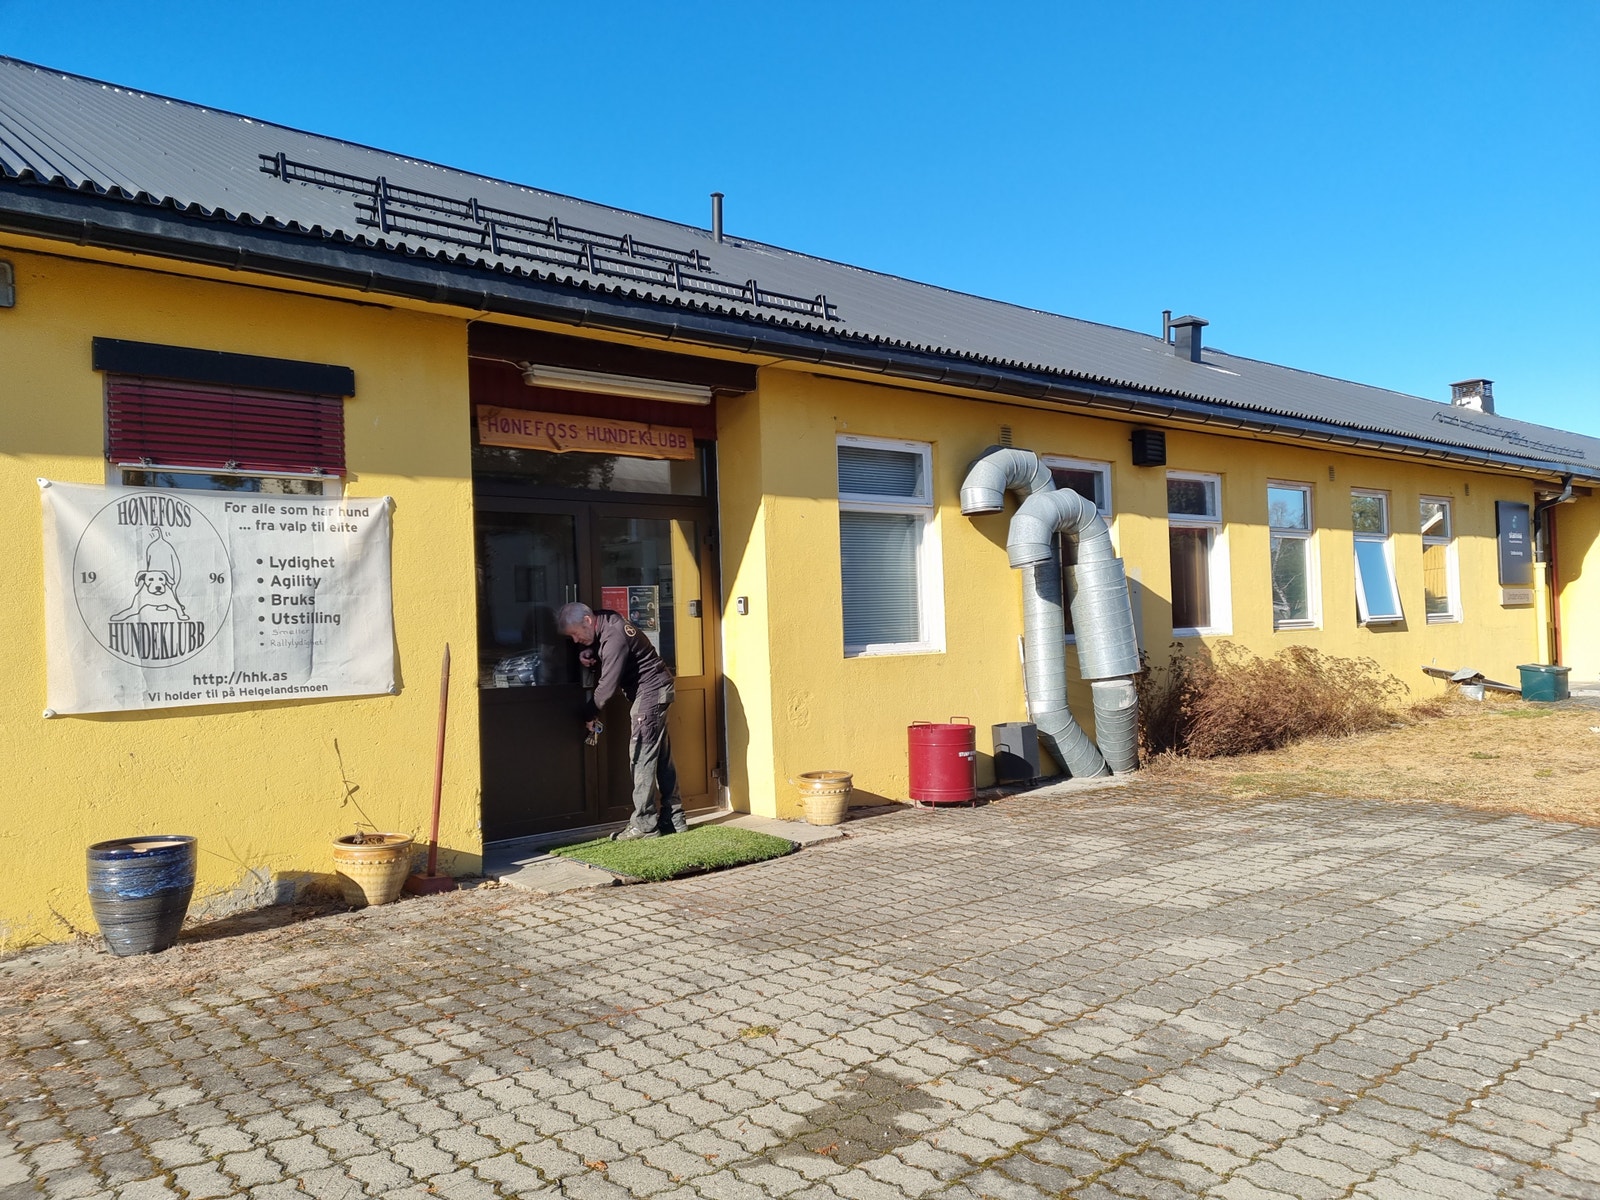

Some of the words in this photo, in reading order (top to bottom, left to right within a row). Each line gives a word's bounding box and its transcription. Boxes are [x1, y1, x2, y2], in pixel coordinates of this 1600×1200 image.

[487, 417, 578, 440] HØNEFOSS
[586, 425, 687, 449] HUNDEKLUBB
[117, 496, 192, 528] HØNEFOSS
[224, 502, 247, 513] For
[251, 503, 276, 514] alle
[280, 506, 308, 515] som
[312, 505, 334, 516] har
[338, 507, 369, 517] hund
[255, 520, 275, 531] fra
[279, 521, 307, 534] valp
[311, 521, 325, 532] til
[329, 522, 358, 533] elite
[269, 556, 335, 571] Lydighet
[80, 571, 97, 584] 19
[209, 572, 225, 584] 96
[270, 574, 321, 590] Agility
[271, 593, 315, 606] Bruks
[271, 612, 341, 626] Utstilling
[108, 621, 205, 660] HUNDEKLUBB
[270, 638, 324, 649] Rallylydiget
[193, 671, 288, 687] http://hhk.as
[148, 691, 161, 702] Vi
[164, 690, 201, 701] holder
[206, 688, 218, 699] til
[222, 687, 236, 699] på
[239, 683, 329, 697] Helgelandsmoen
